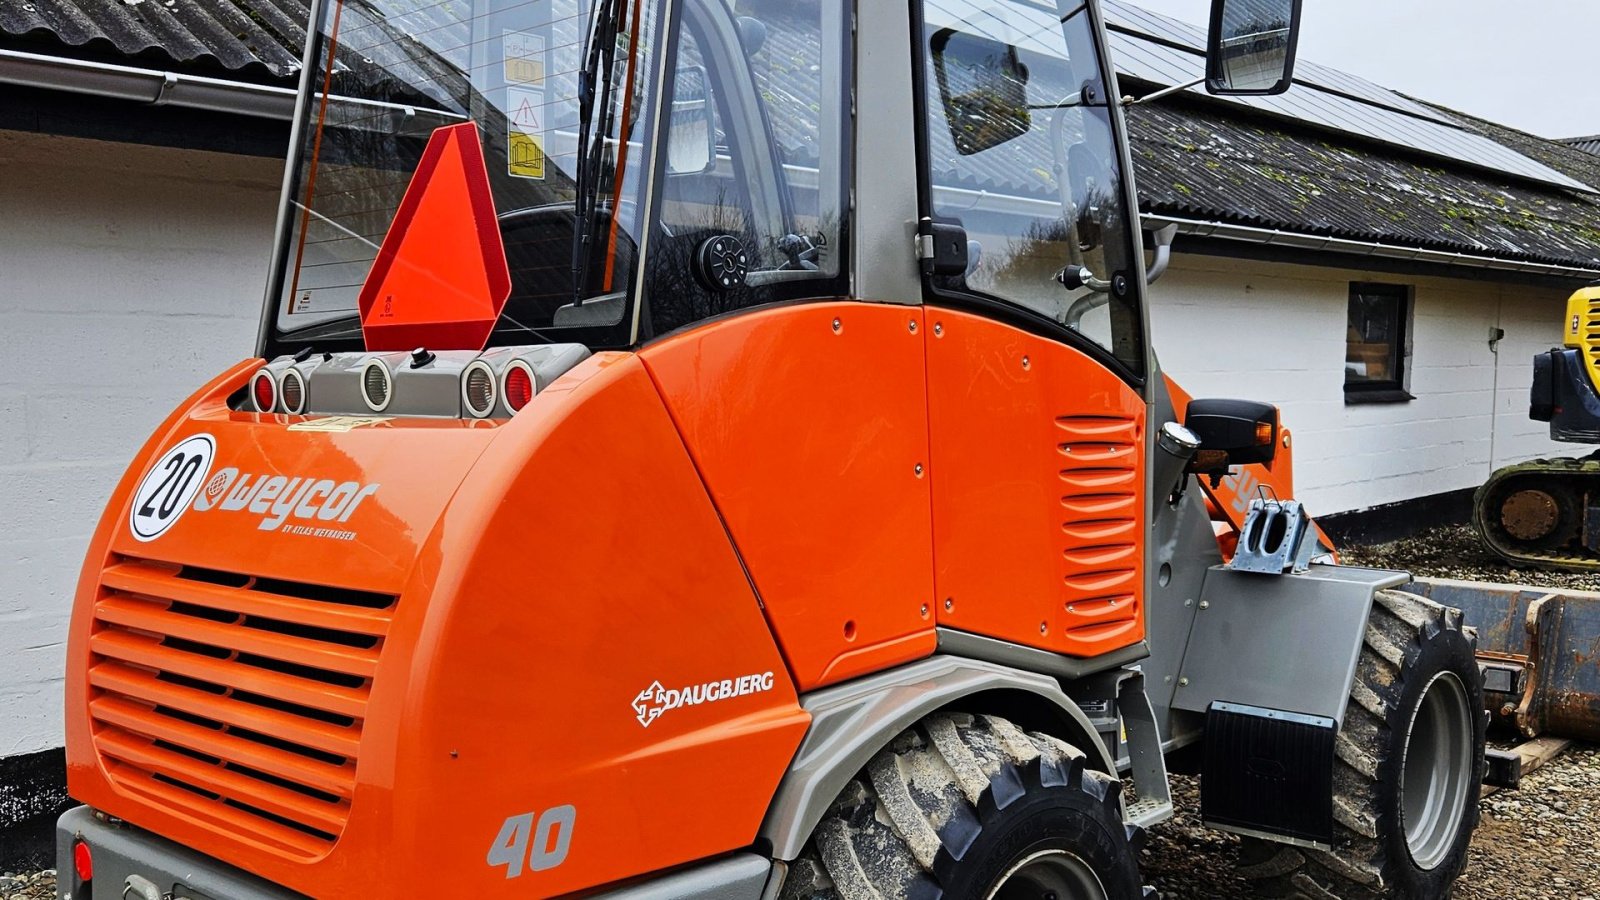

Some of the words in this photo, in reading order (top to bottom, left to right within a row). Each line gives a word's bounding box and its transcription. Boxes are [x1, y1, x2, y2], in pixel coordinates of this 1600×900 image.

[138, 452, 203, 520] 20
[219, 473, 381, 531] weycor
[282, 524, 294, 533] BY
[292, 525, 314, 536] ATLAS
[314, 528, 357, 540] WEYHAUSEN
[665, 671, 774, 710] DAUGBJERG
[487, 804, 577, 879] 40
